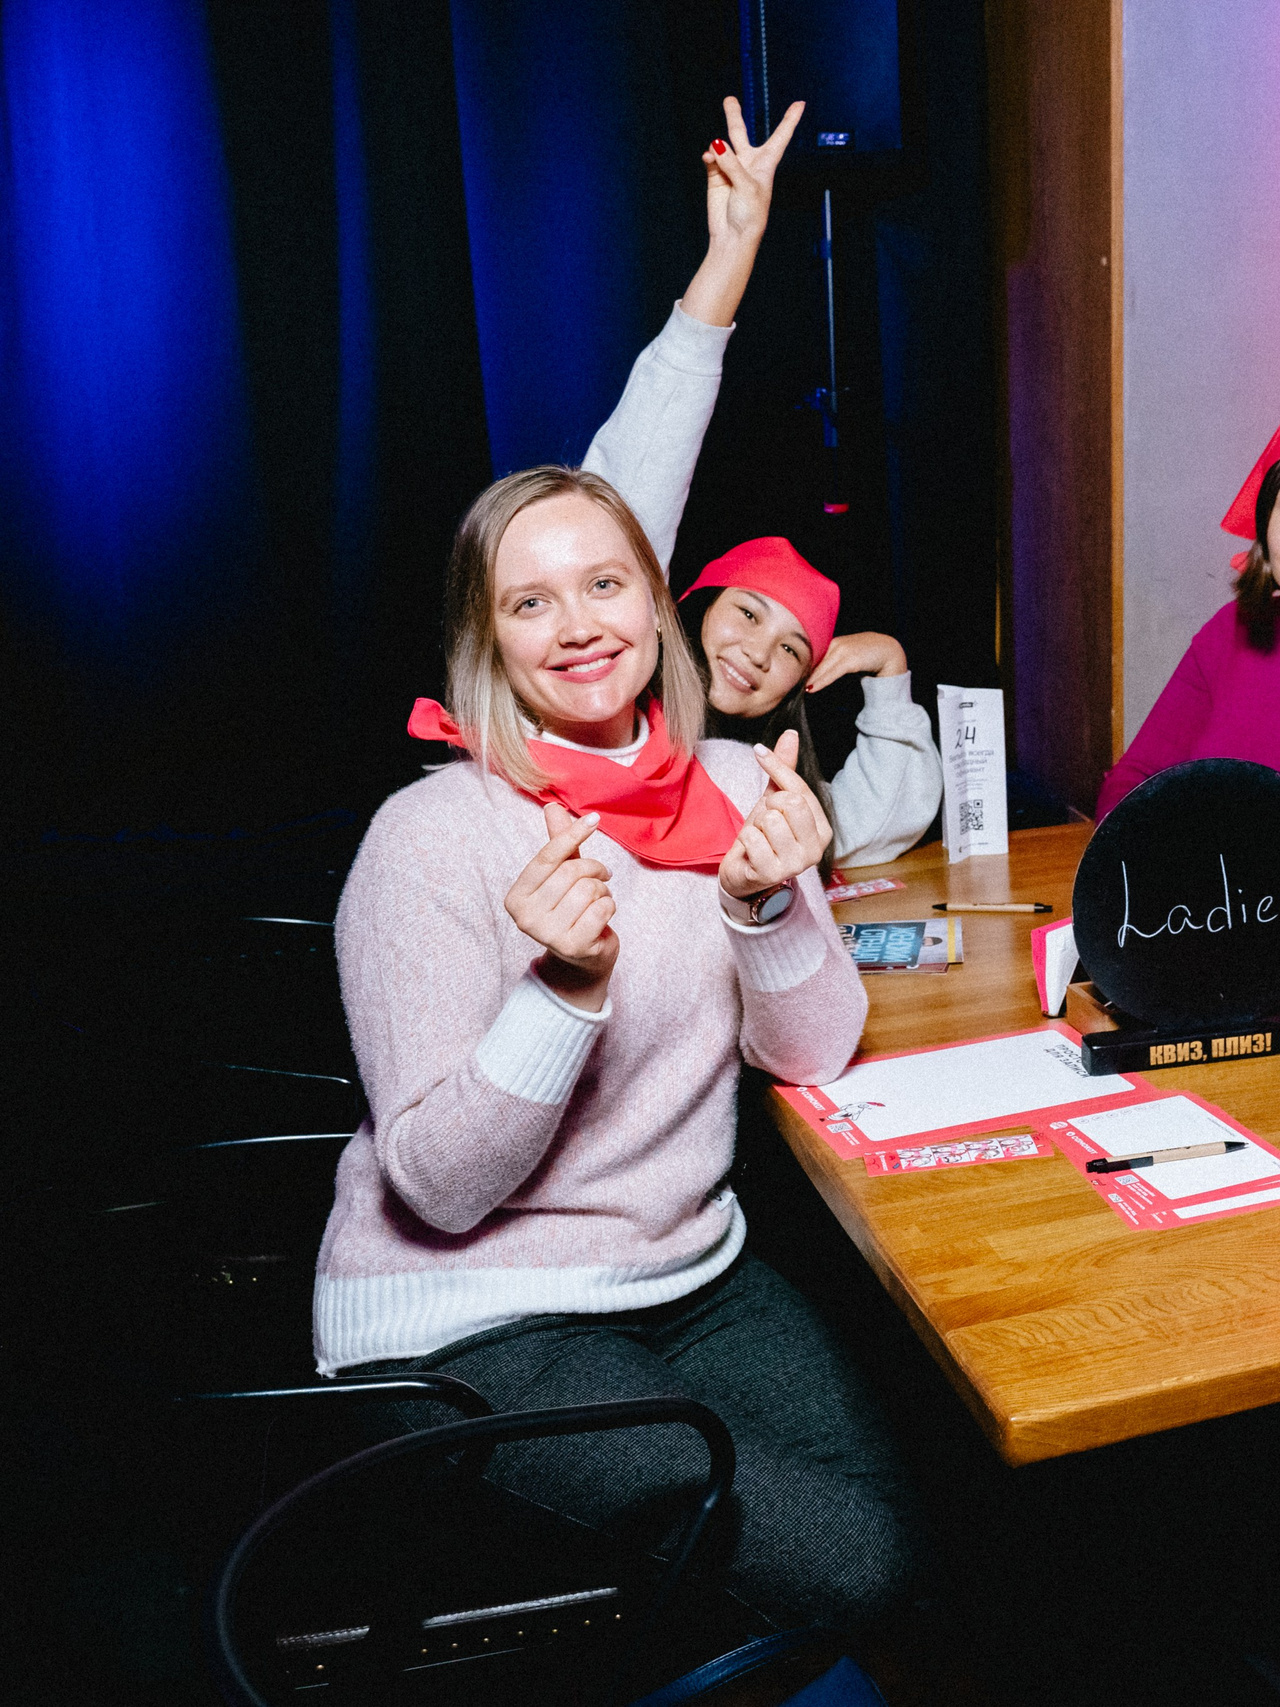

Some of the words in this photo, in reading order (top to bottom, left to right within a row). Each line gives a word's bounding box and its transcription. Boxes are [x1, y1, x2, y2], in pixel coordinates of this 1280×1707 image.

[955, 725, 976, 749] 24
[1149, 1041, 1208, 1066] КВИЗ,
[1211, 1032, 1272, 1058] ПЛИЗ!
